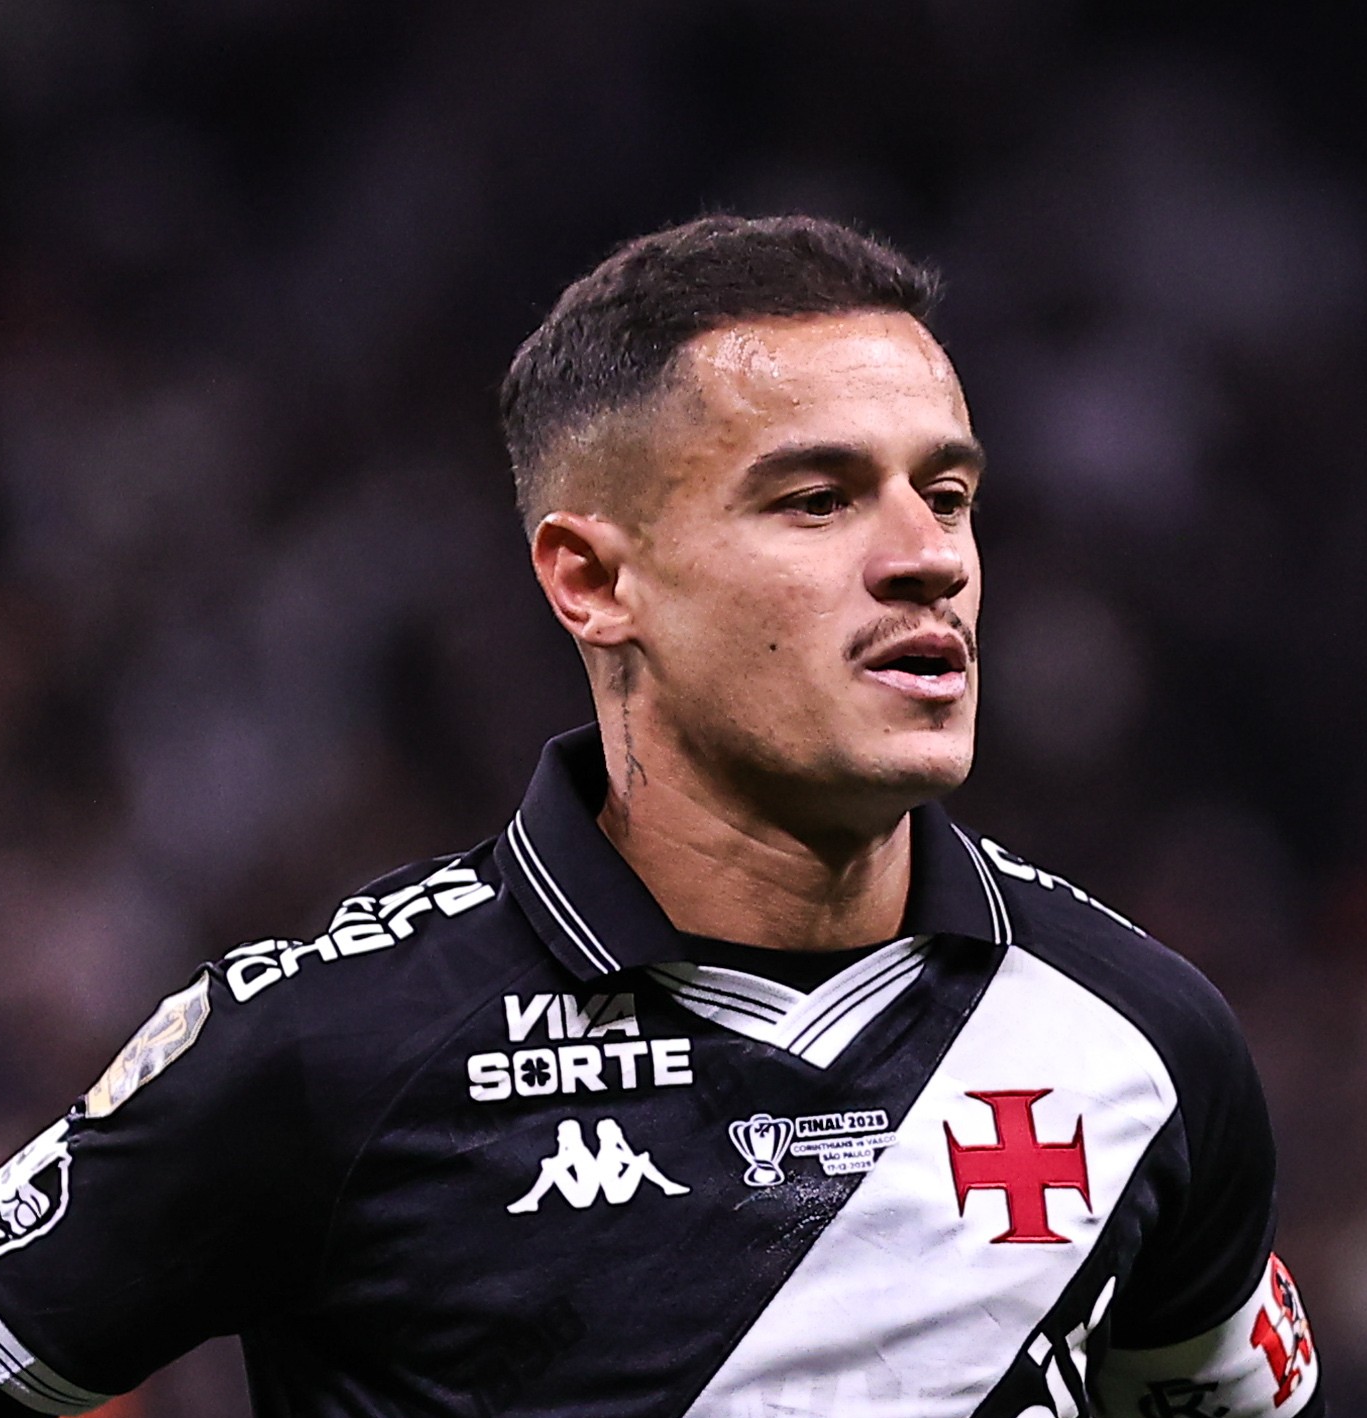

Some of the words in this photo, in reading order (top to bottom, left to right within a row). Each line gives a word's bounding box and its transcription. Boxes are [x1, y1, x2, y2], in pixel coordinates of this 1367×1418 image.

[504, 993, 640, 1042] VIVA
[467, 1038, 693, 1101] SORTE
[799, 1117, 844, 1133] FINAL
[793, 1141, 853, 1153] CORINTHIANS
[866, 1135, 897, 1146] VASCO
[823, 1151, 840, 1161] SÃO
[843, 1149, 872, 1159] PAULO
